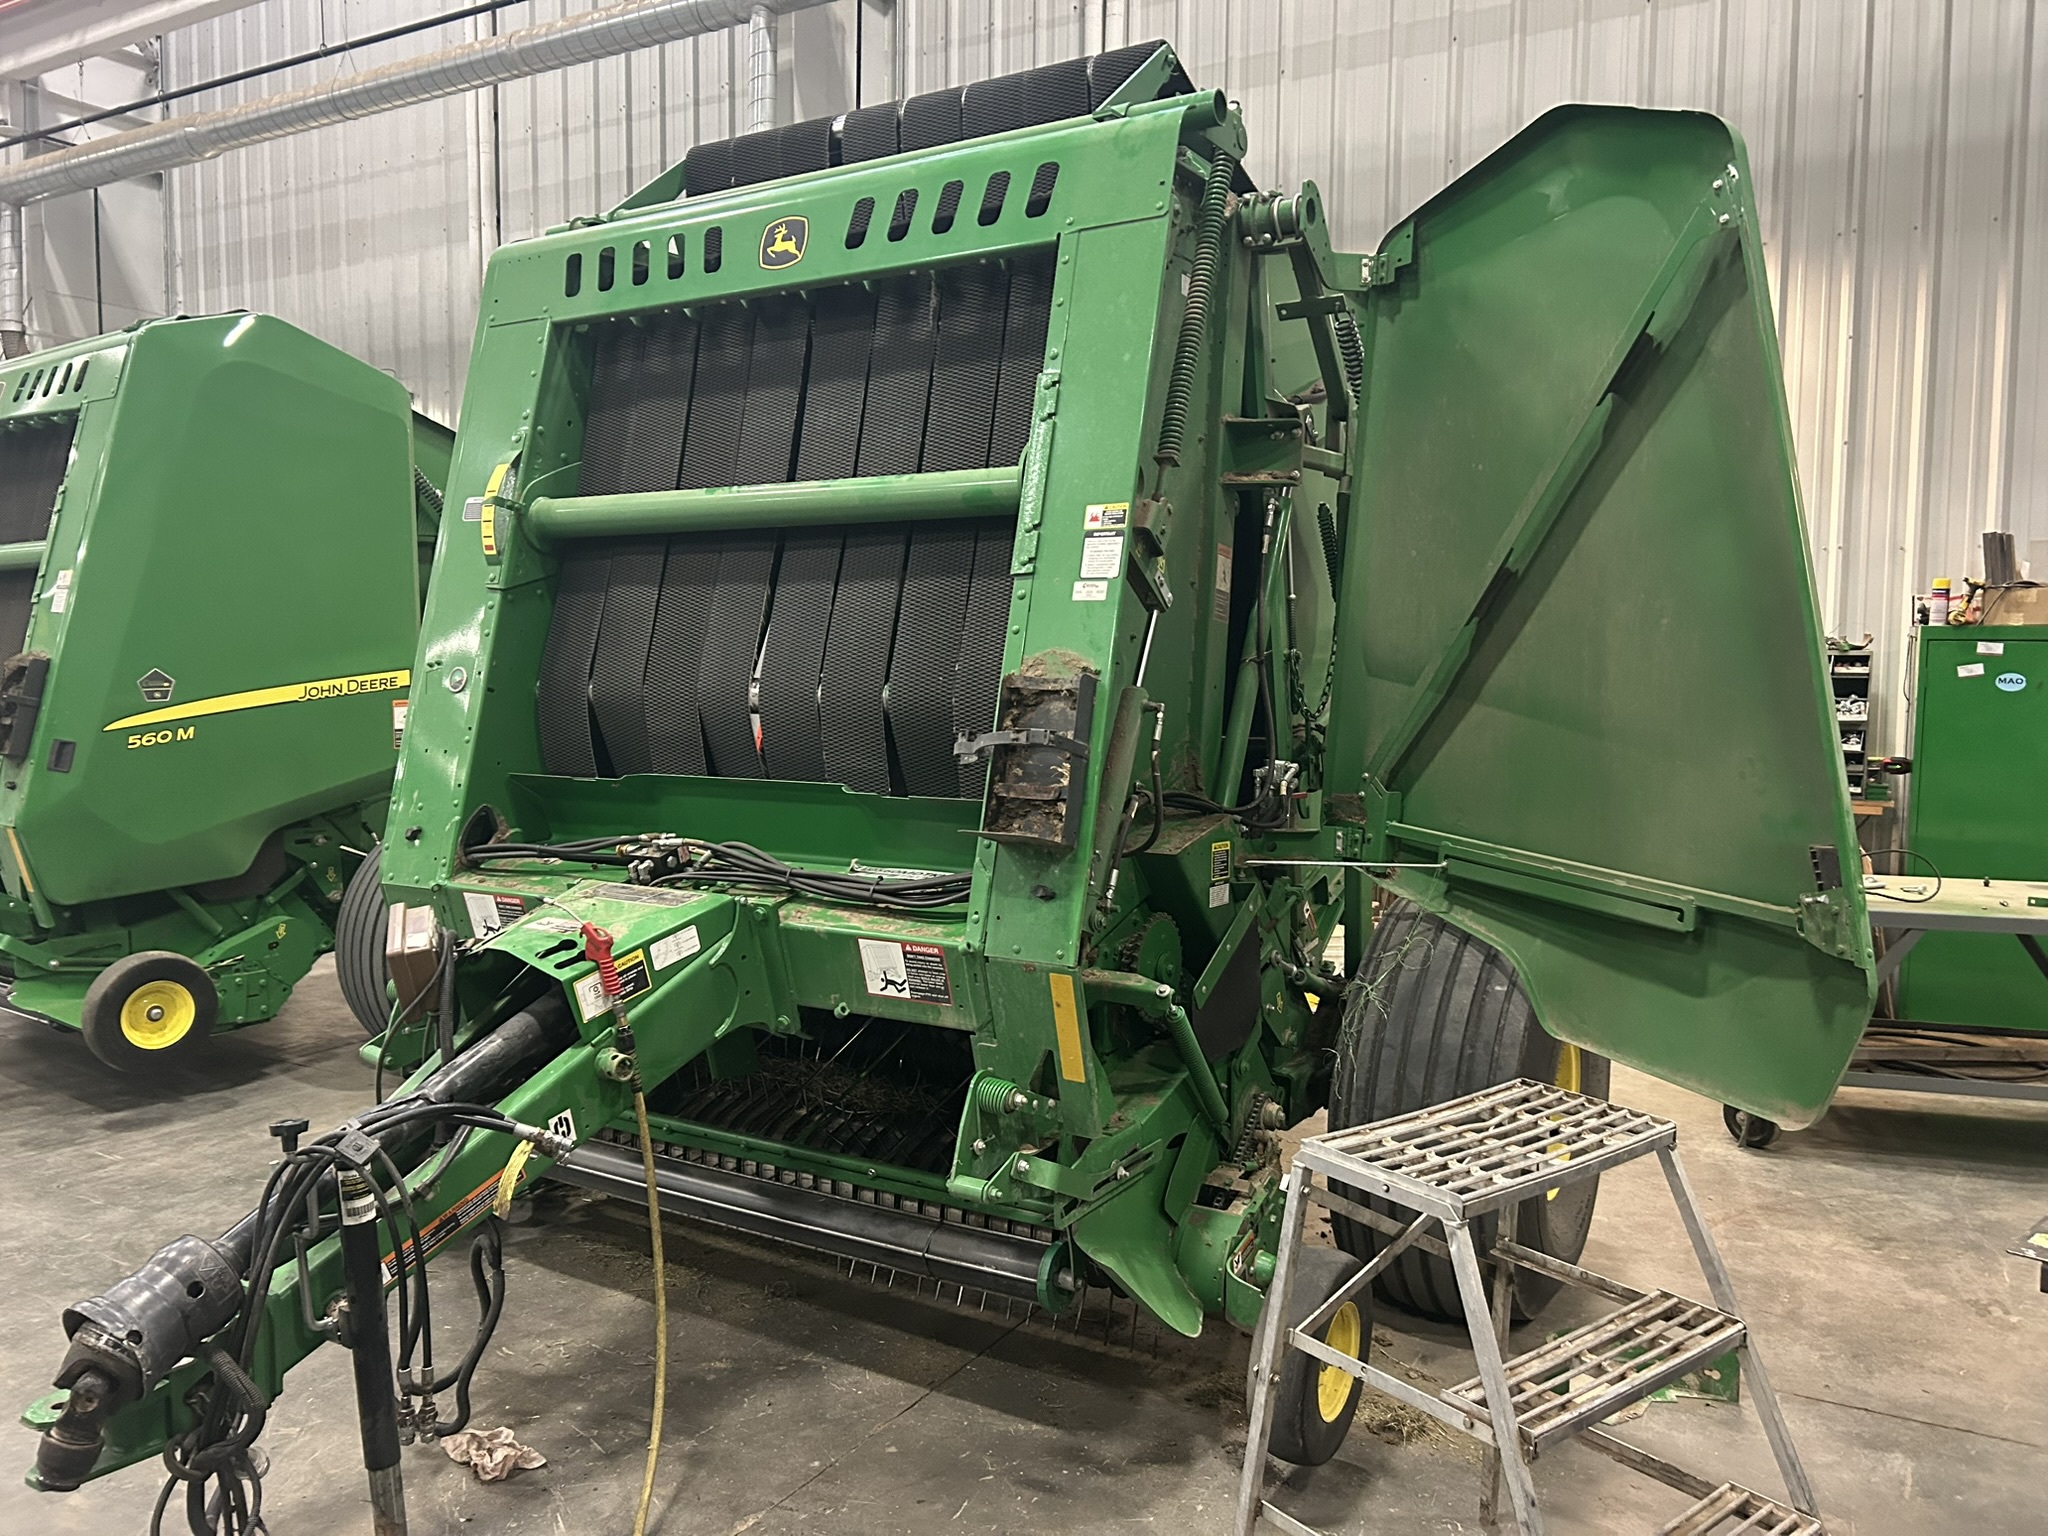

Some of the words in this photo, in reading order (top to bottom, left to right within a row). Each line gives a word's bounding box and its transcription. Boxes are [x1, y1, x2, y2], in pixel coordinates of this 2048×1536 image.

[298, 683, 342, 699] JOHN
[347, 676, 398, 692] DEERE
[127, 730, 173, 748] 560
[176, 726, 195, 741] M
[912, 945, 939, 954] DANGER
[617, 954, 640, 969] CAUTION
